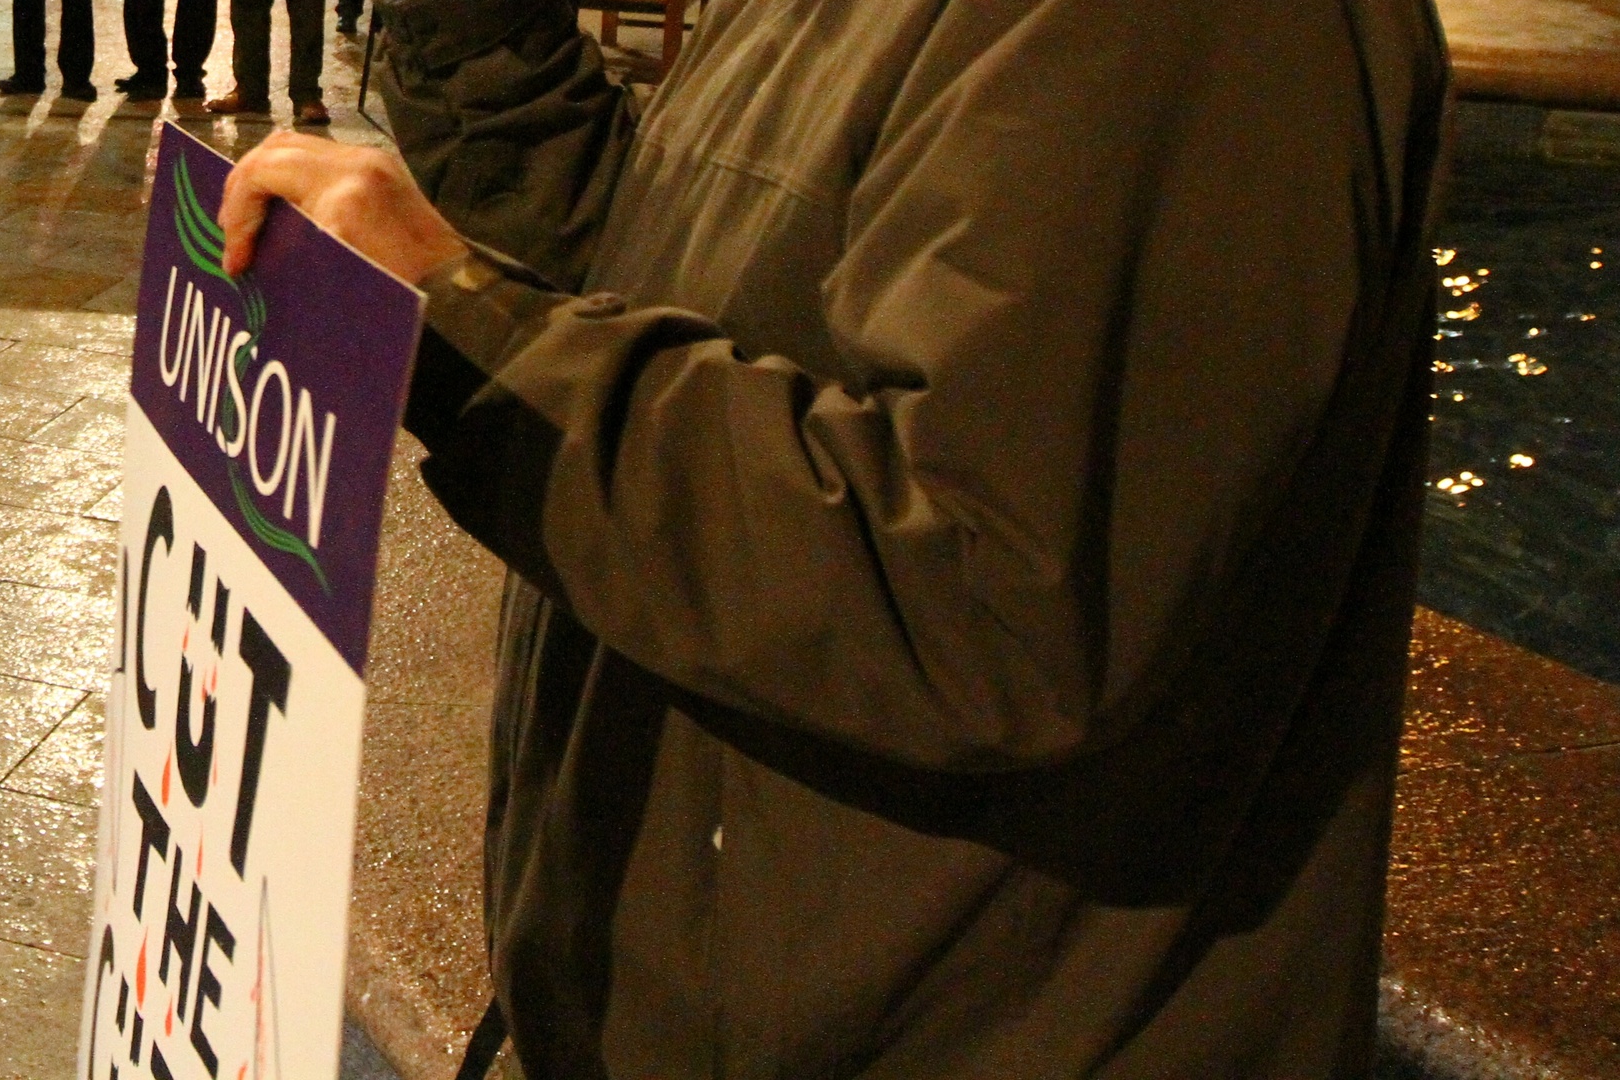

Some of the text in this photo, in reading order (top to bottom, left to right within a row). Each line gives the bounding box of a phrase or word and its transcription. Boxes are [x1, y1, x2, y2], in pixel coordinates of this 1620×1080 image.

[158, 265, 336, 550] UNISON
[136, 485, 293, 881] CUT
[132, 768, 236, 1080] THE
